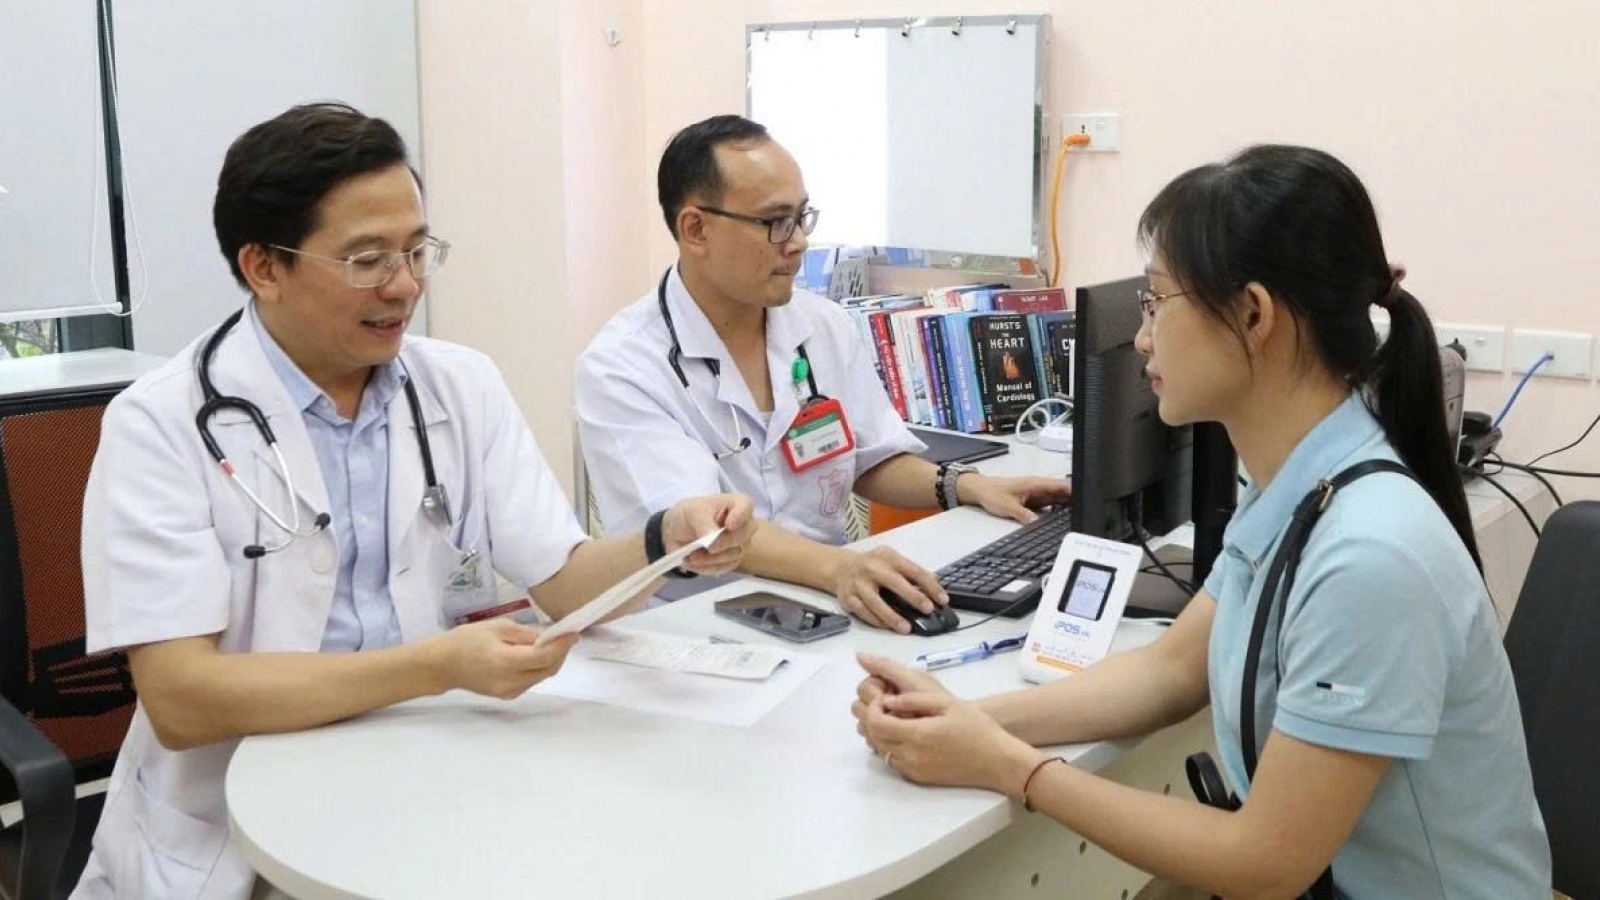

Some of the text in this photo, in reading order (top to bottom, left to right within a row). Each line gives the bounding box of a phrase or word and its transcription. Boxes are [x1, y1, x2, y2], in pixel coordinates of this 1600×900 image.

[990, 337, 1025, 349] HEART
[996, 381, 1032, 392] Manual of
[996, 392, 1035, 403] Cardiology
